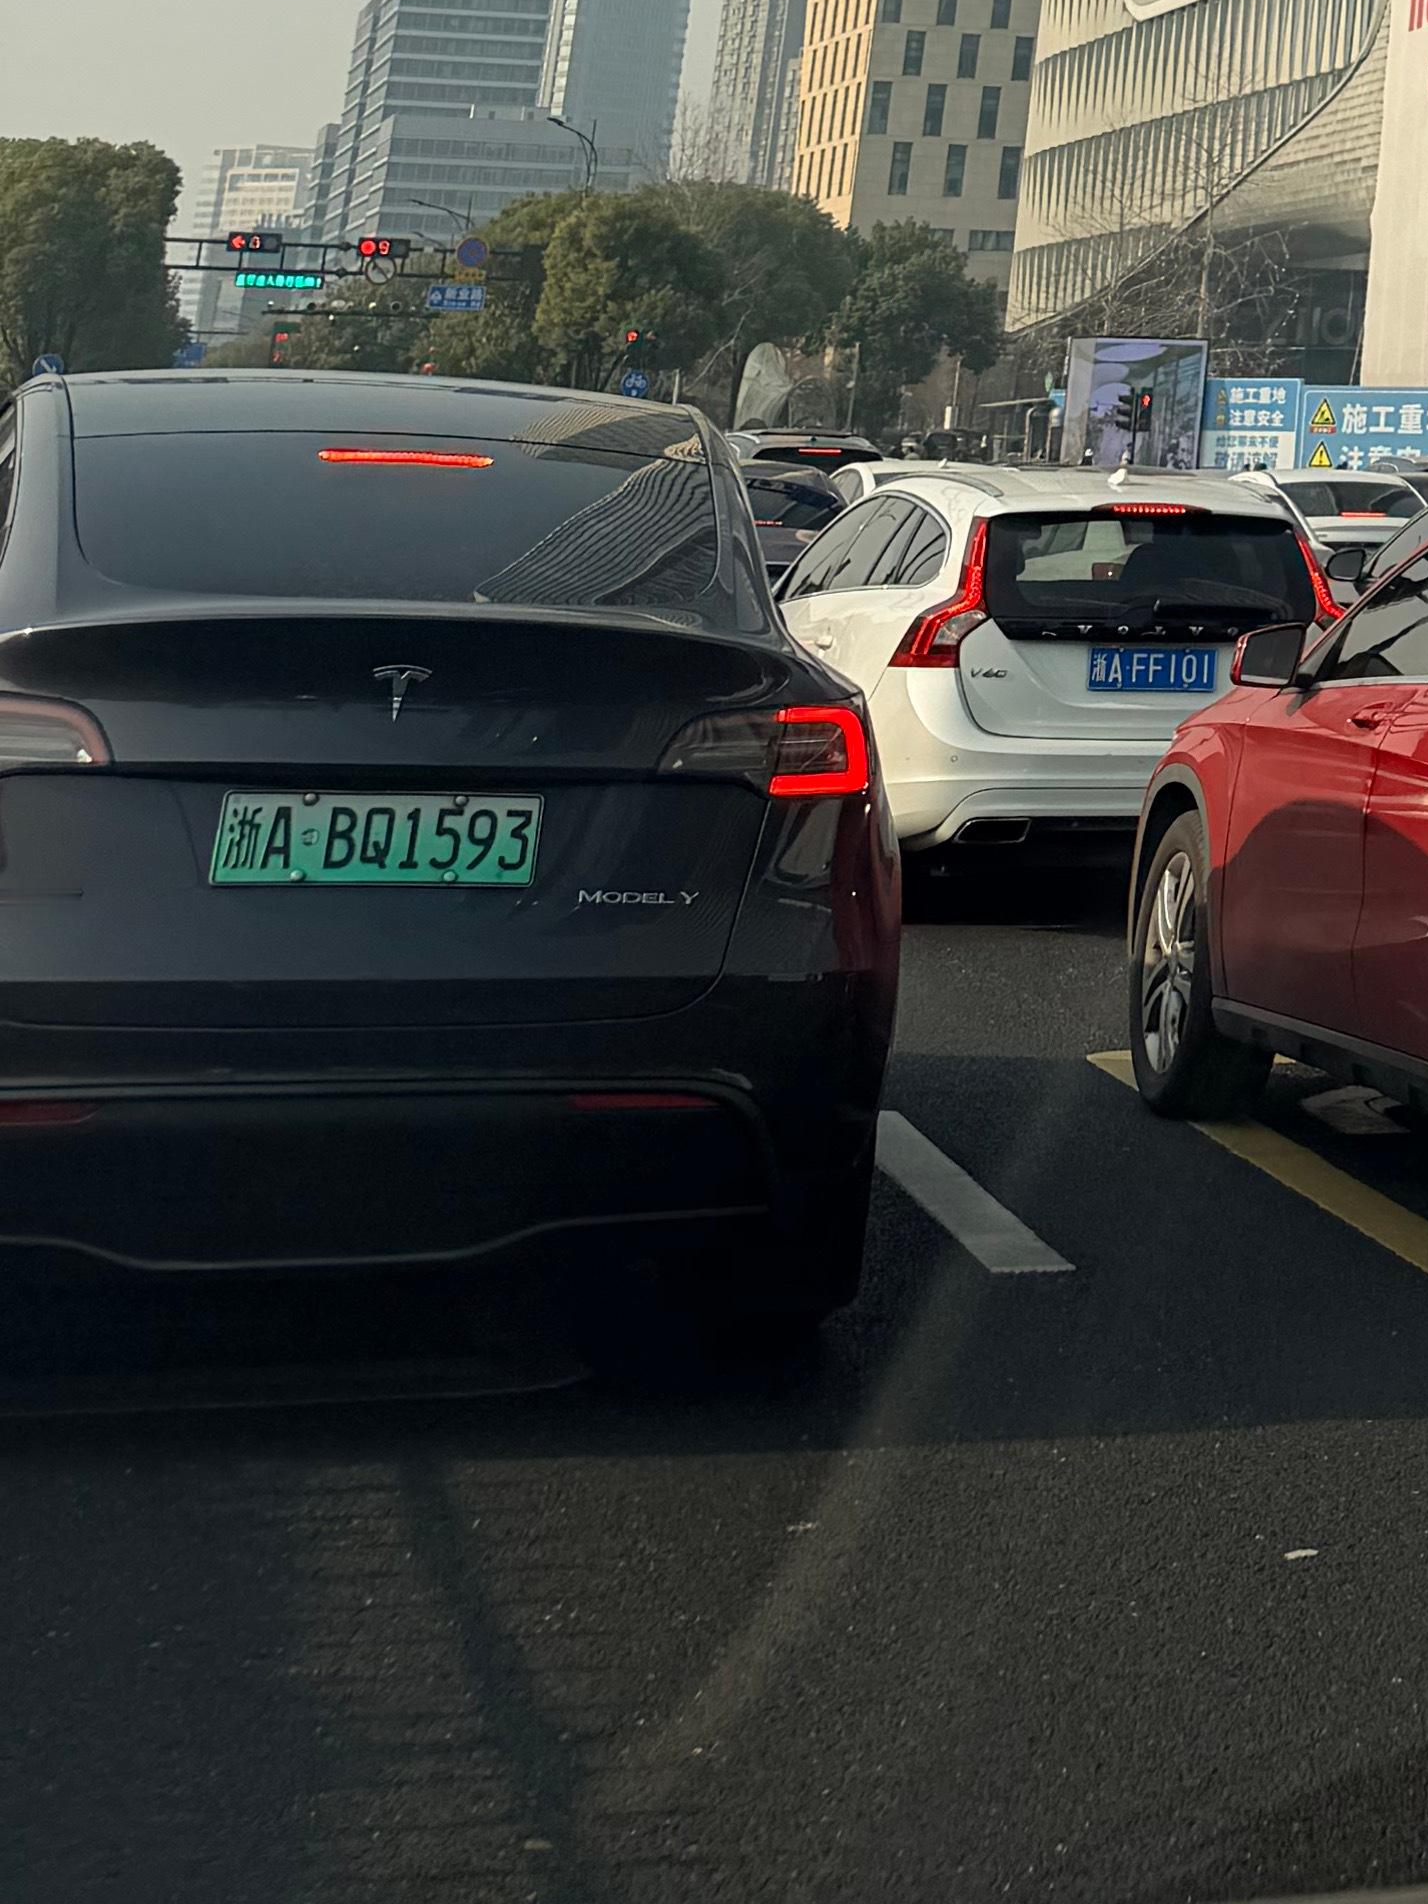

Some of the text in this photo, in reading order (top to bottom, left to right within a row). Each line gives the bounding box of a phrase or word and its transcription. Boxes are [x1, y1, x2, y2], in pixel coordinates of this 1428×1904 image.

[1230, 386, 1287, 405] 施工重地
[1229, 409, 1285, 427] 注意安全
[1077, 624, 1239, 636] VOLVO
[970, 667, 1008, 679] V60
[577, 889, 700, 906] MODEL Y
